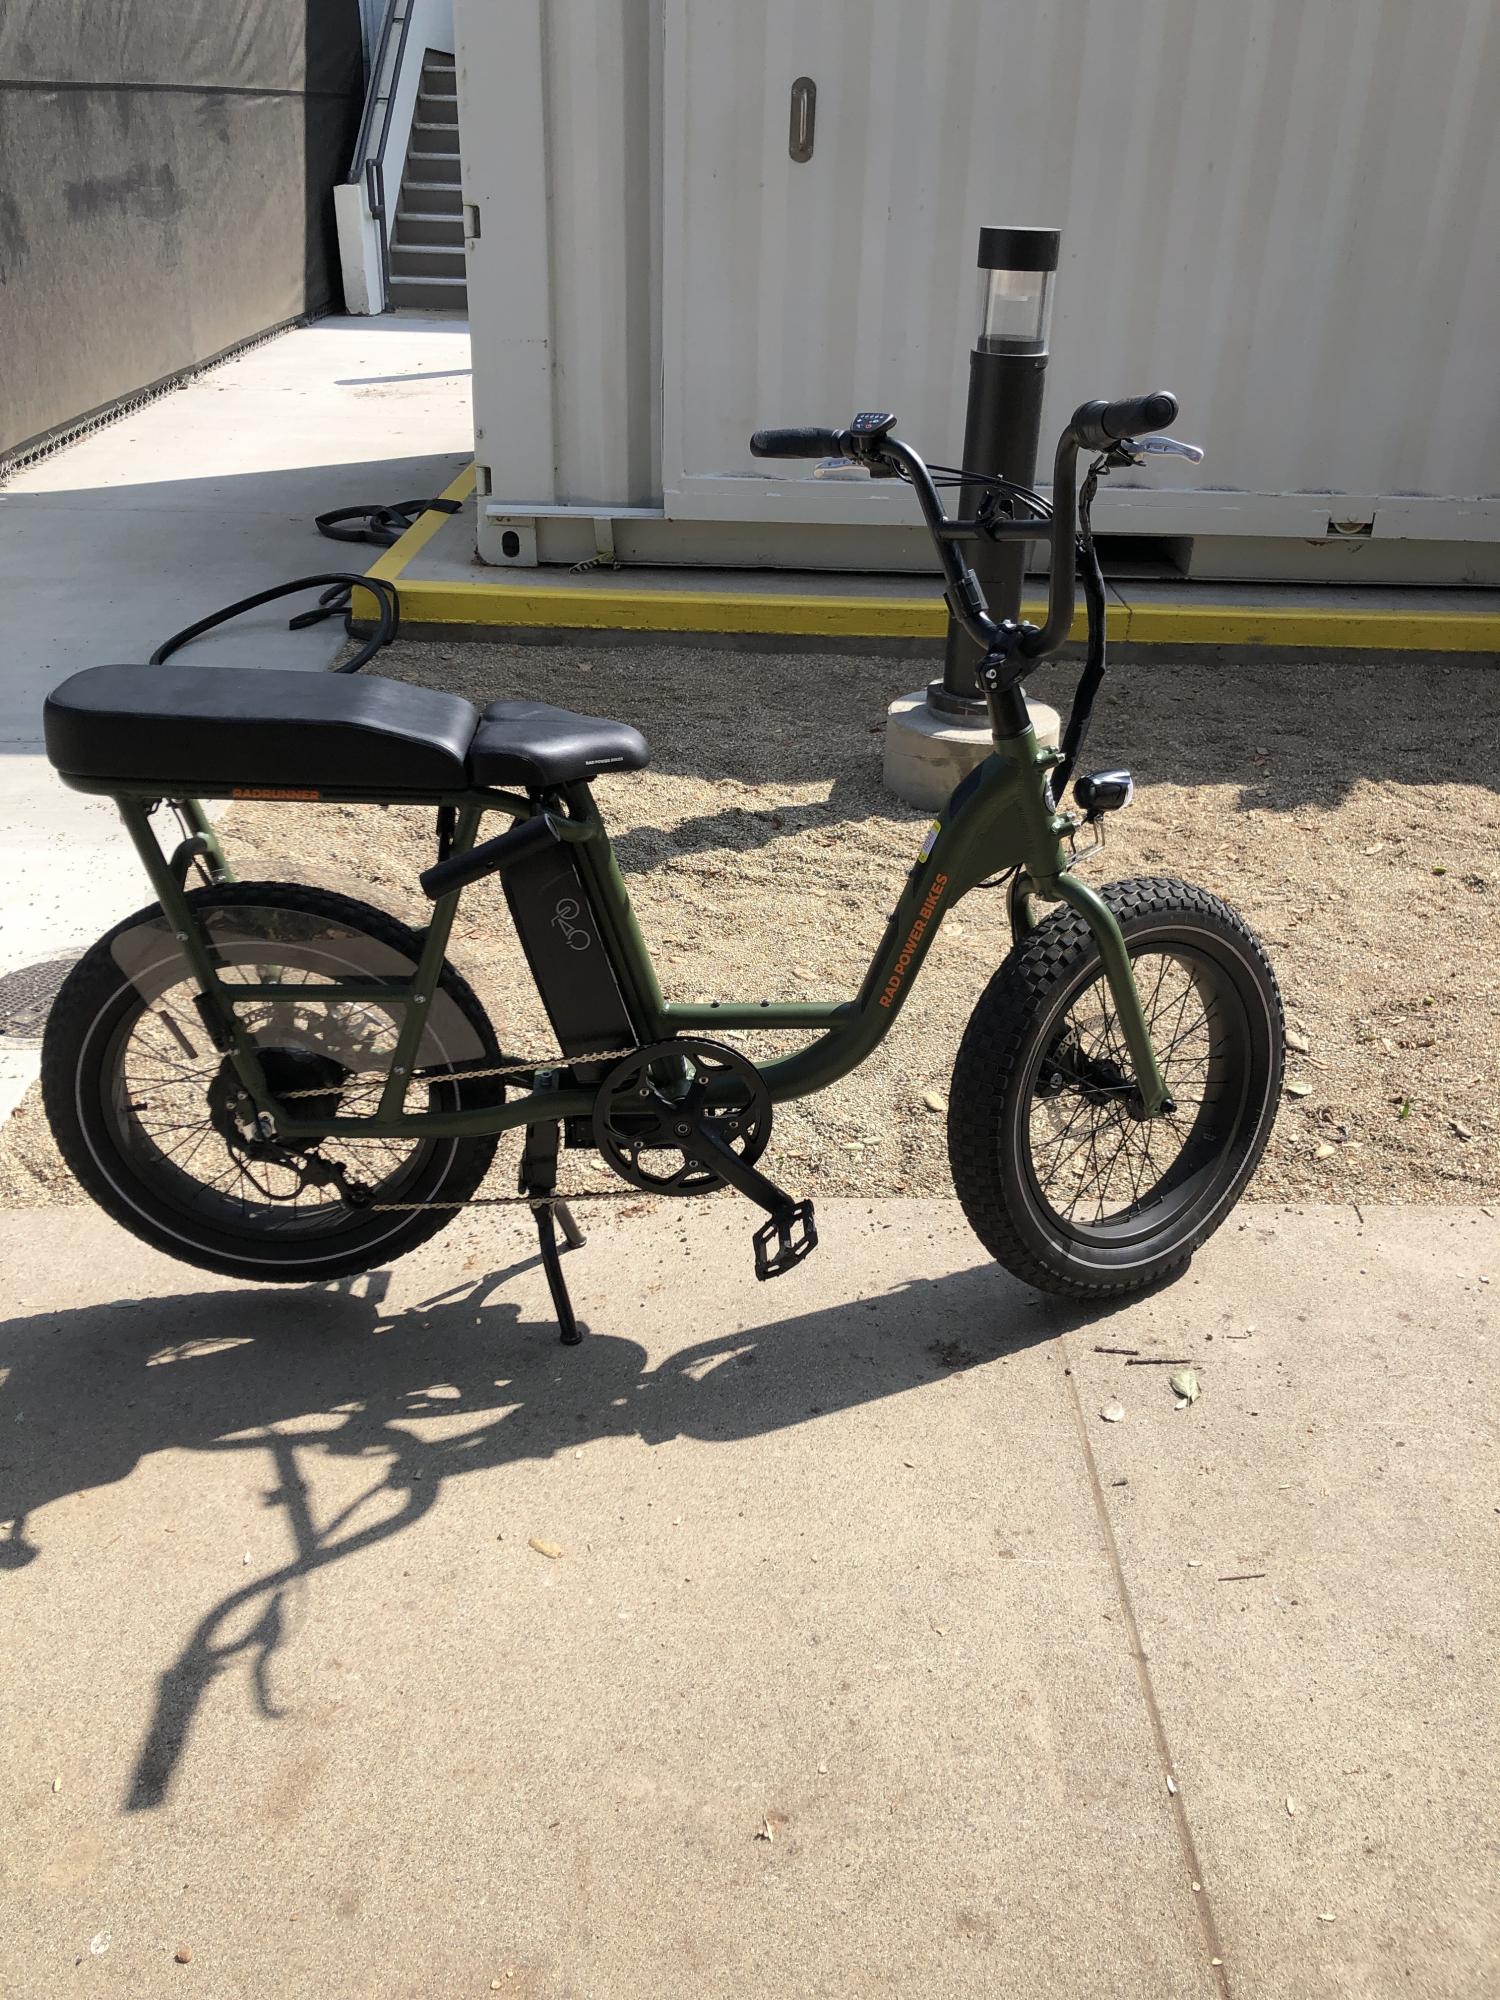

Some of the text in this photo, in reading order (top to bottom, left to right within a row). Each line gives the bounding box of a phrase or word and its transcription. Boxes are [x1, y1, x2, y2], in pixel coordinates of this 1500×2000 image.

[232, 788, 320, 800] RADRUNNER
[879, 975, 901, 1008] RAD
[894, 919, 926, 976] POWER
[920, 873, 948, 920] BIKES
